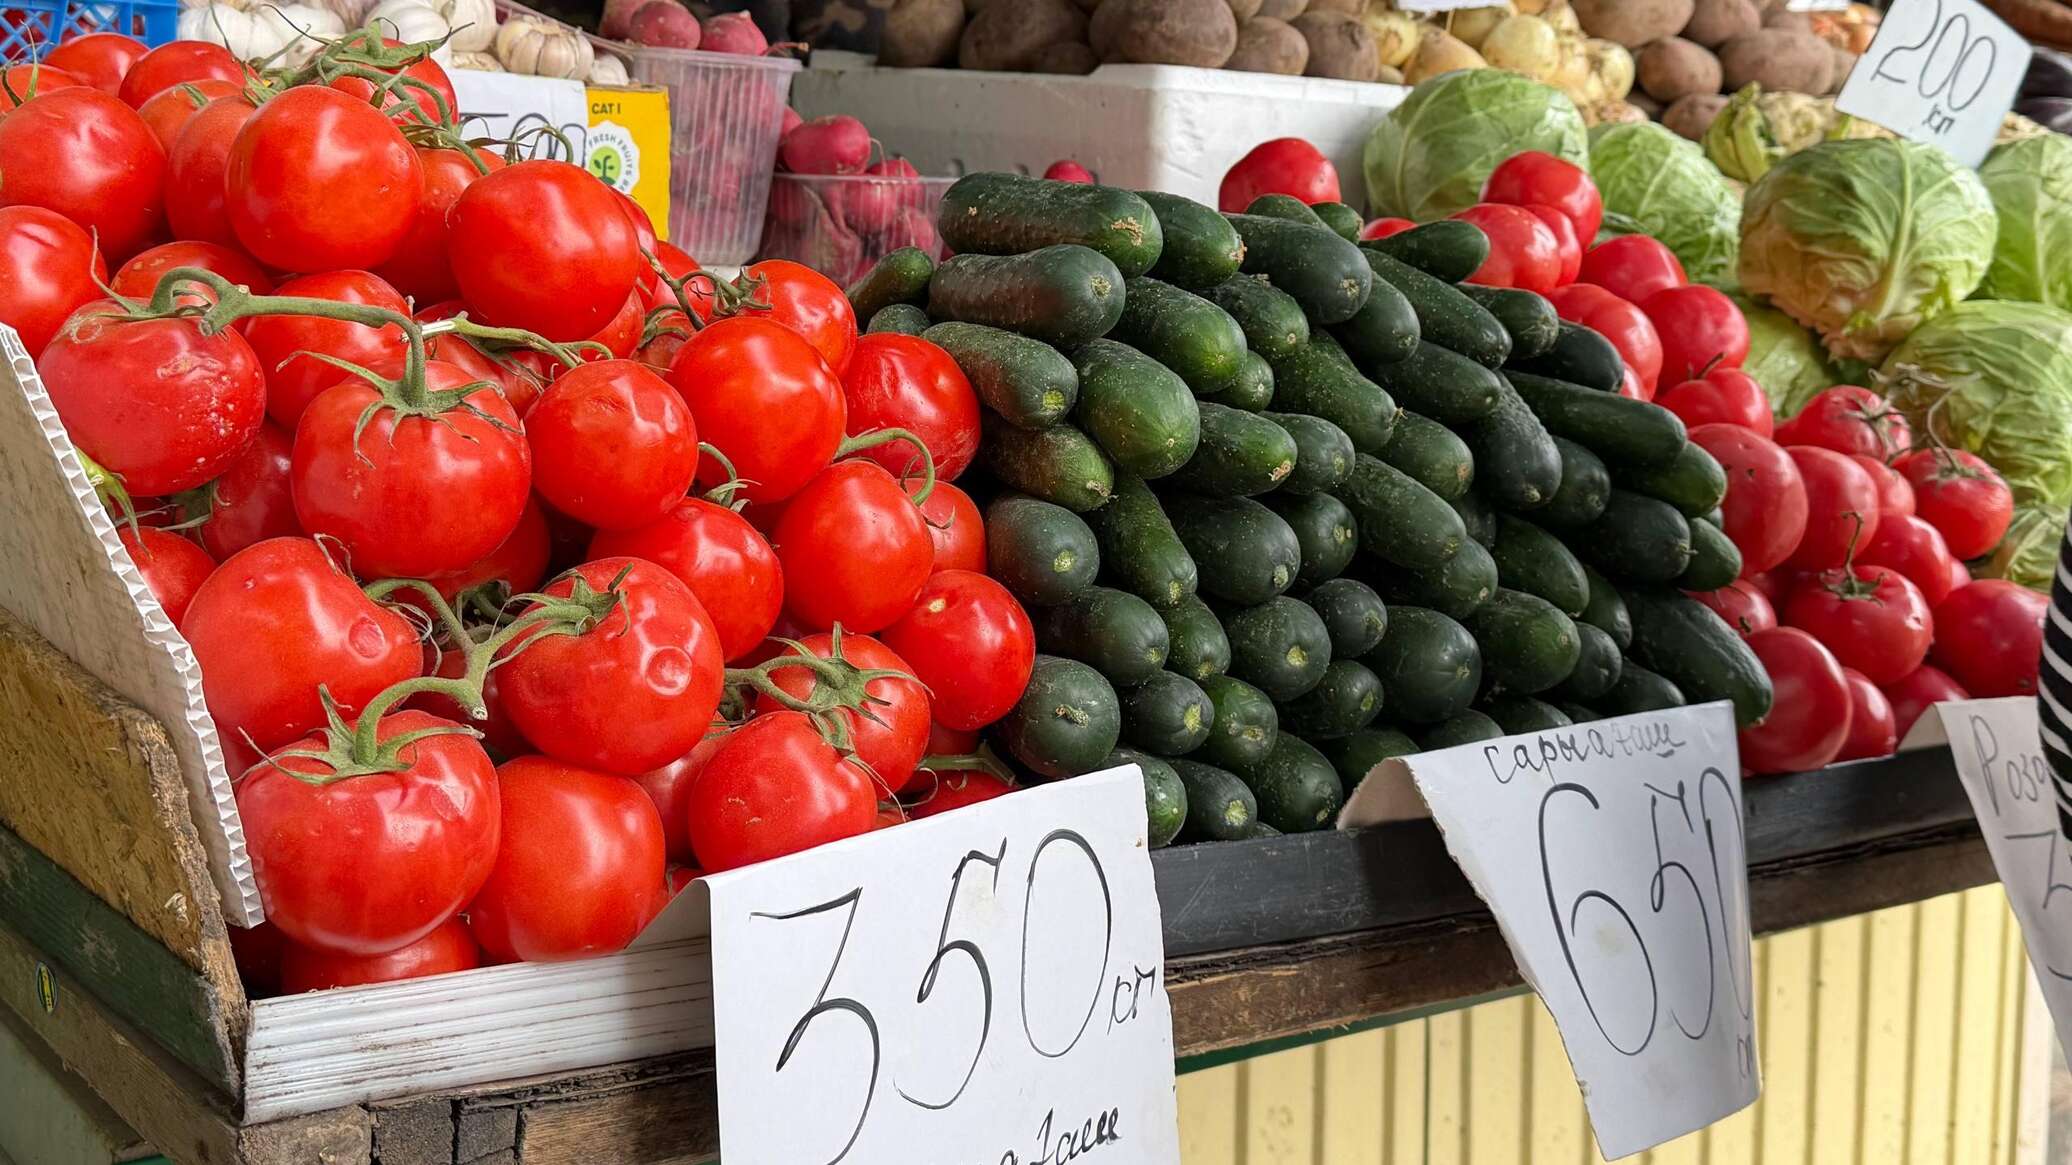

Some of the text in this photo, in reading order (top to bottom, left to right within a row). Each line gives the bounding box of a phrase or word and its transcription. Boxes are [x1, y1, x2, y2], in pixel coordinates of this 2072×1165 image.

[592, 103, 614, 114] CAT
[1871, 0, 1997, 112] 200
[588, 133, 633, 176] FRESH FRUITS
[1539, 767, 1751, 1056] 650
[749, 828, 1112, 1165] 350
